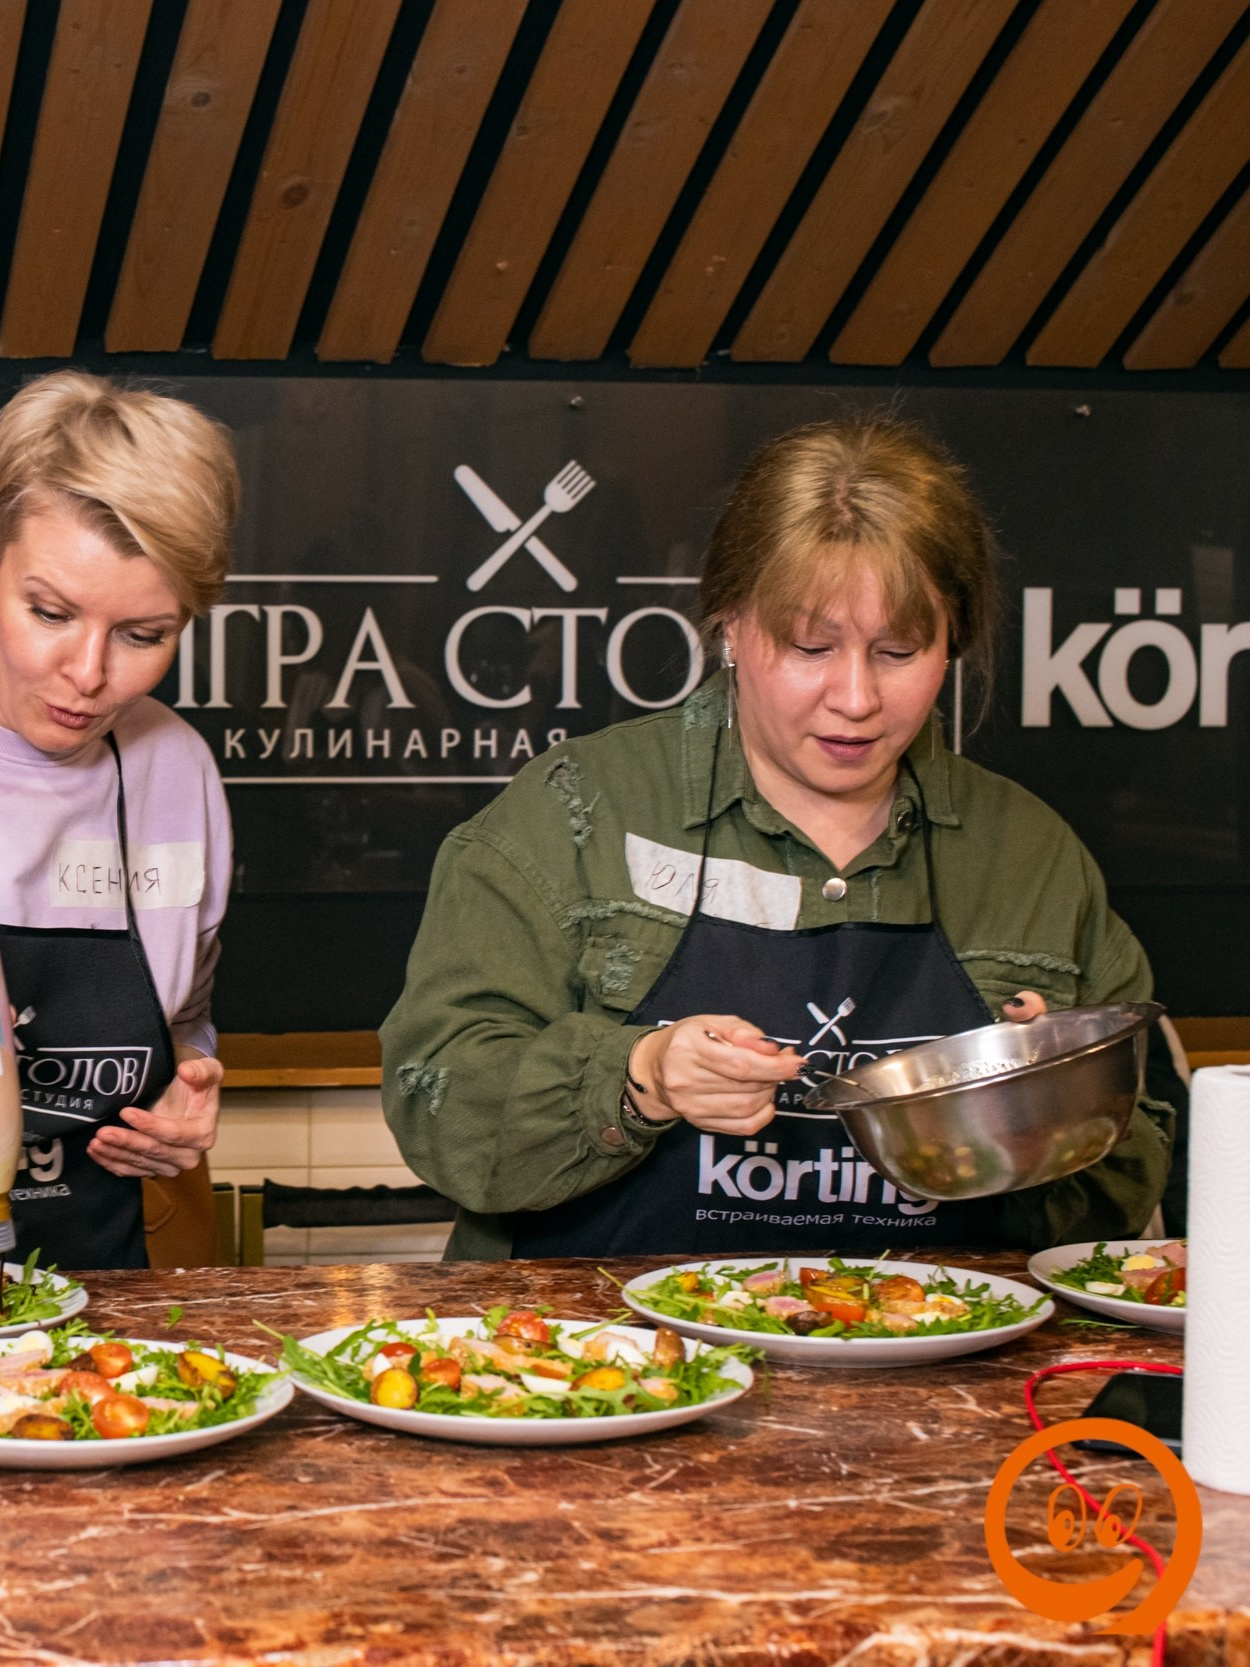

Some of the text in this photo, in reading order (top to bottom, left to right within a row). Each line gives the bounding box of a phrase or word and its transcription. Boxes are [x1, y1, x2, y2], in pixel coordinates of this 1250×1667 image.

[58, 862, 162, 895] КСЕНИЯ
[20, 1088, 95, 1111] СТУДИЯ
[695, 1208, 938, 1228] встраиваемая техника
